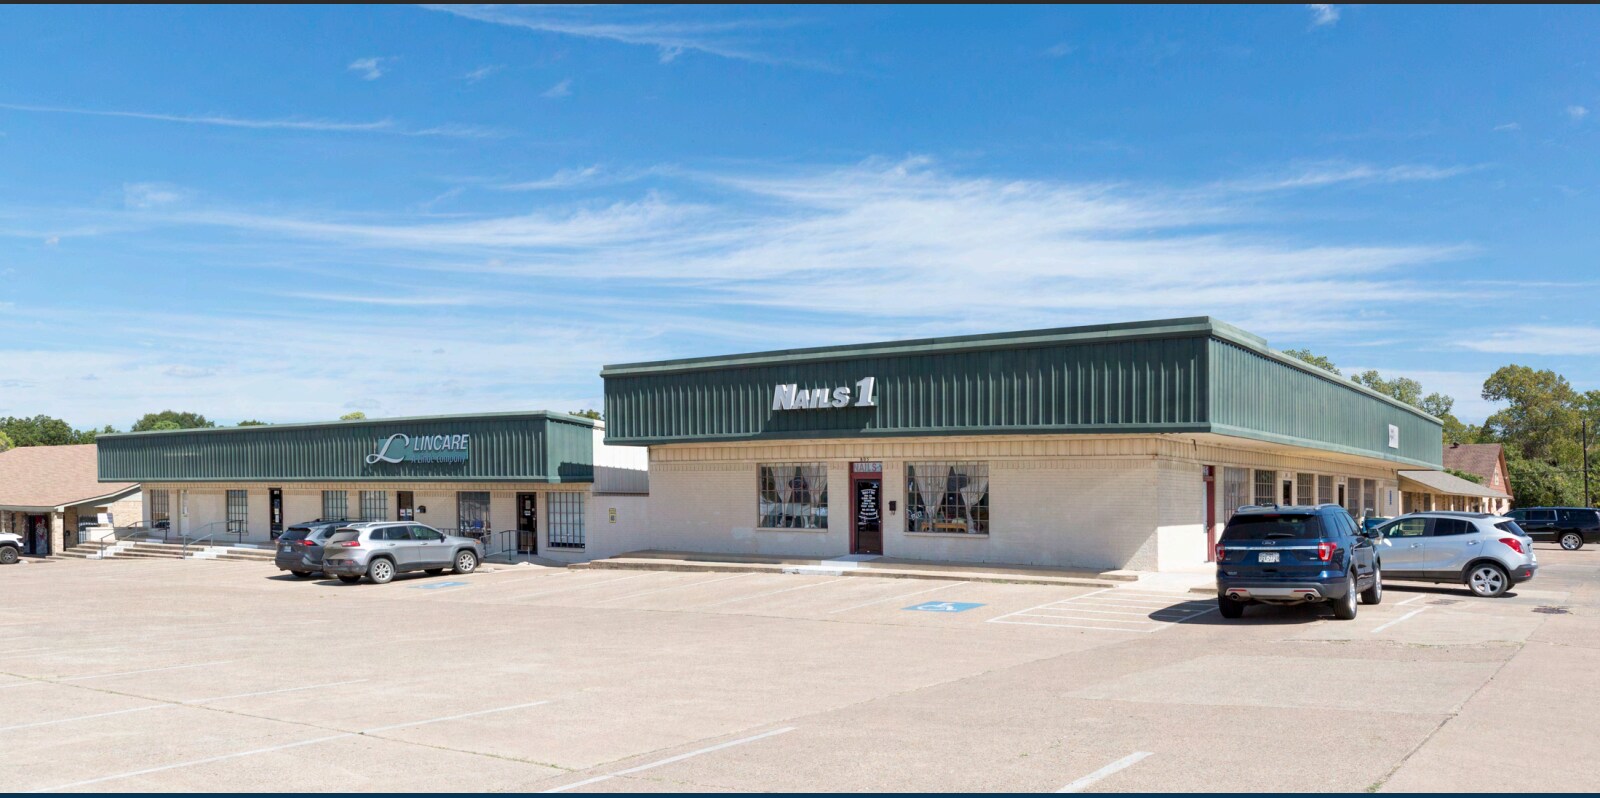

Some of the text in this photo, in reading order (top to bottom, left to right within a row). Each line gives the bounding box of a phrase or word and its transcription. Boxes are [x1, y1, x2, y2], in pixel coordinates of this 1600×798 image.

[772, 376, 875, 411] NAILS 1
[413, 434, 469, 451] LINCARE
